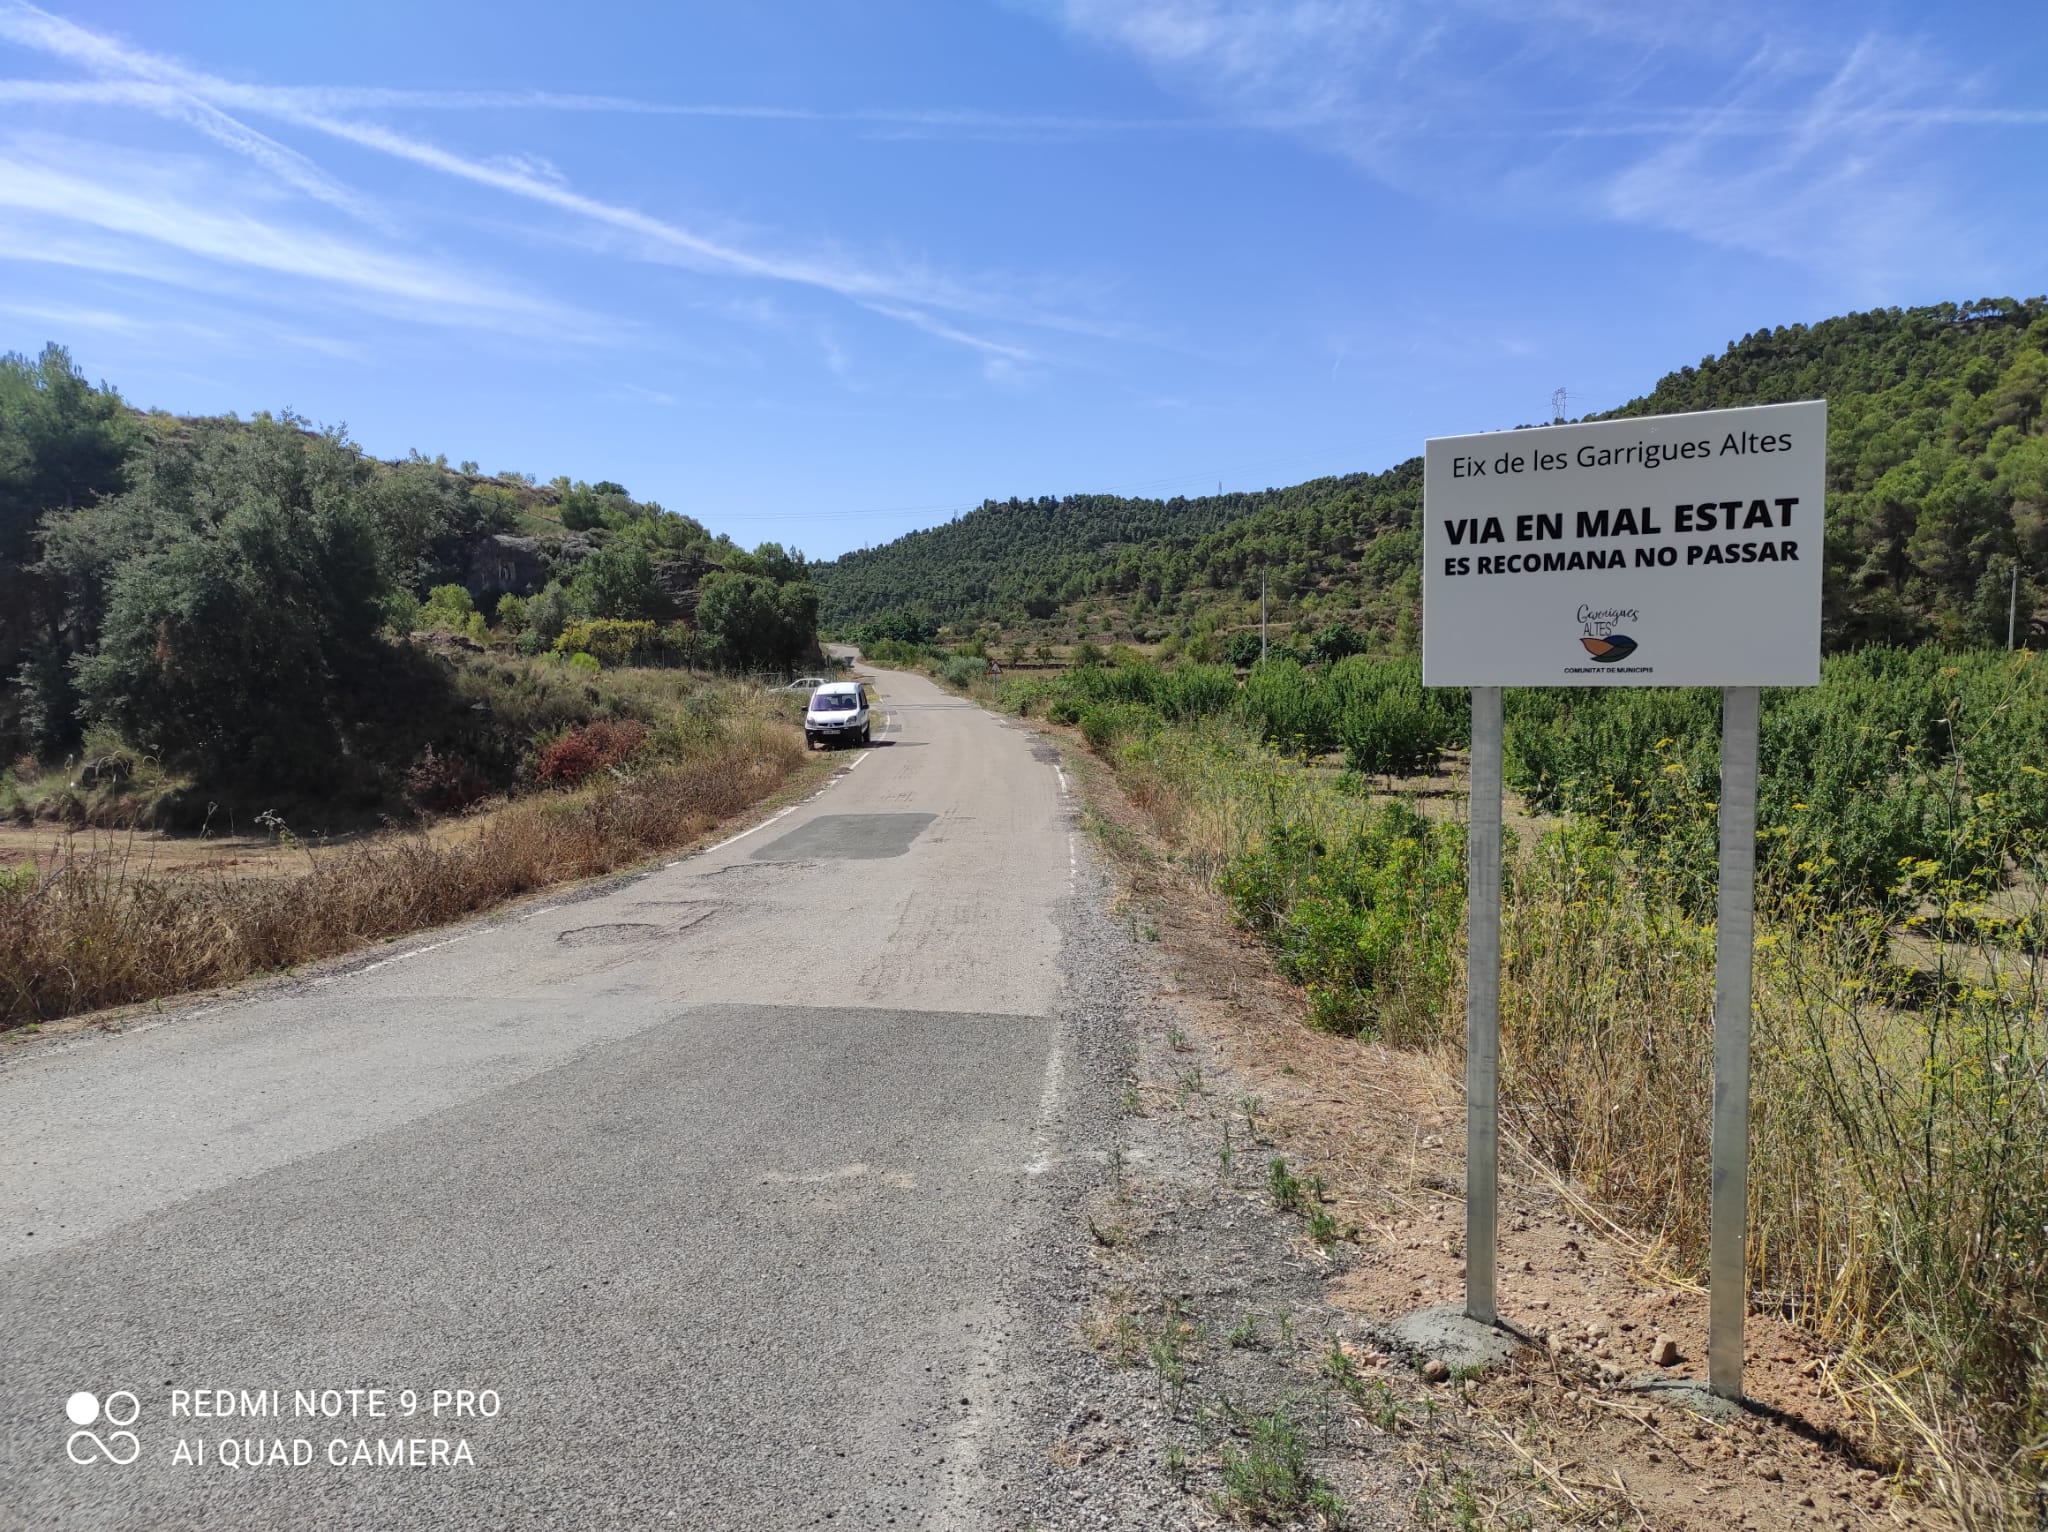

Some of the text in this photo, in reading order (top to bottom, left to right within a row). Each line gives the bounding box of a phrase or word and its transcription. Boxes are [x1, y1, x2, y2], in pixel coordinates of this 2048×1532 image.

[1453, 431, 1792, 478] Eix de les Garrigues Altes
[1444, 497, 1800, 545] VIA EN MAL ESTAT
[1444, 540, 1799, 576] ES RECOMANA NO PASSAR
[1576, 603, 1640, 627] Garrigues
[1583, 621, 1612, 637] ALTES
